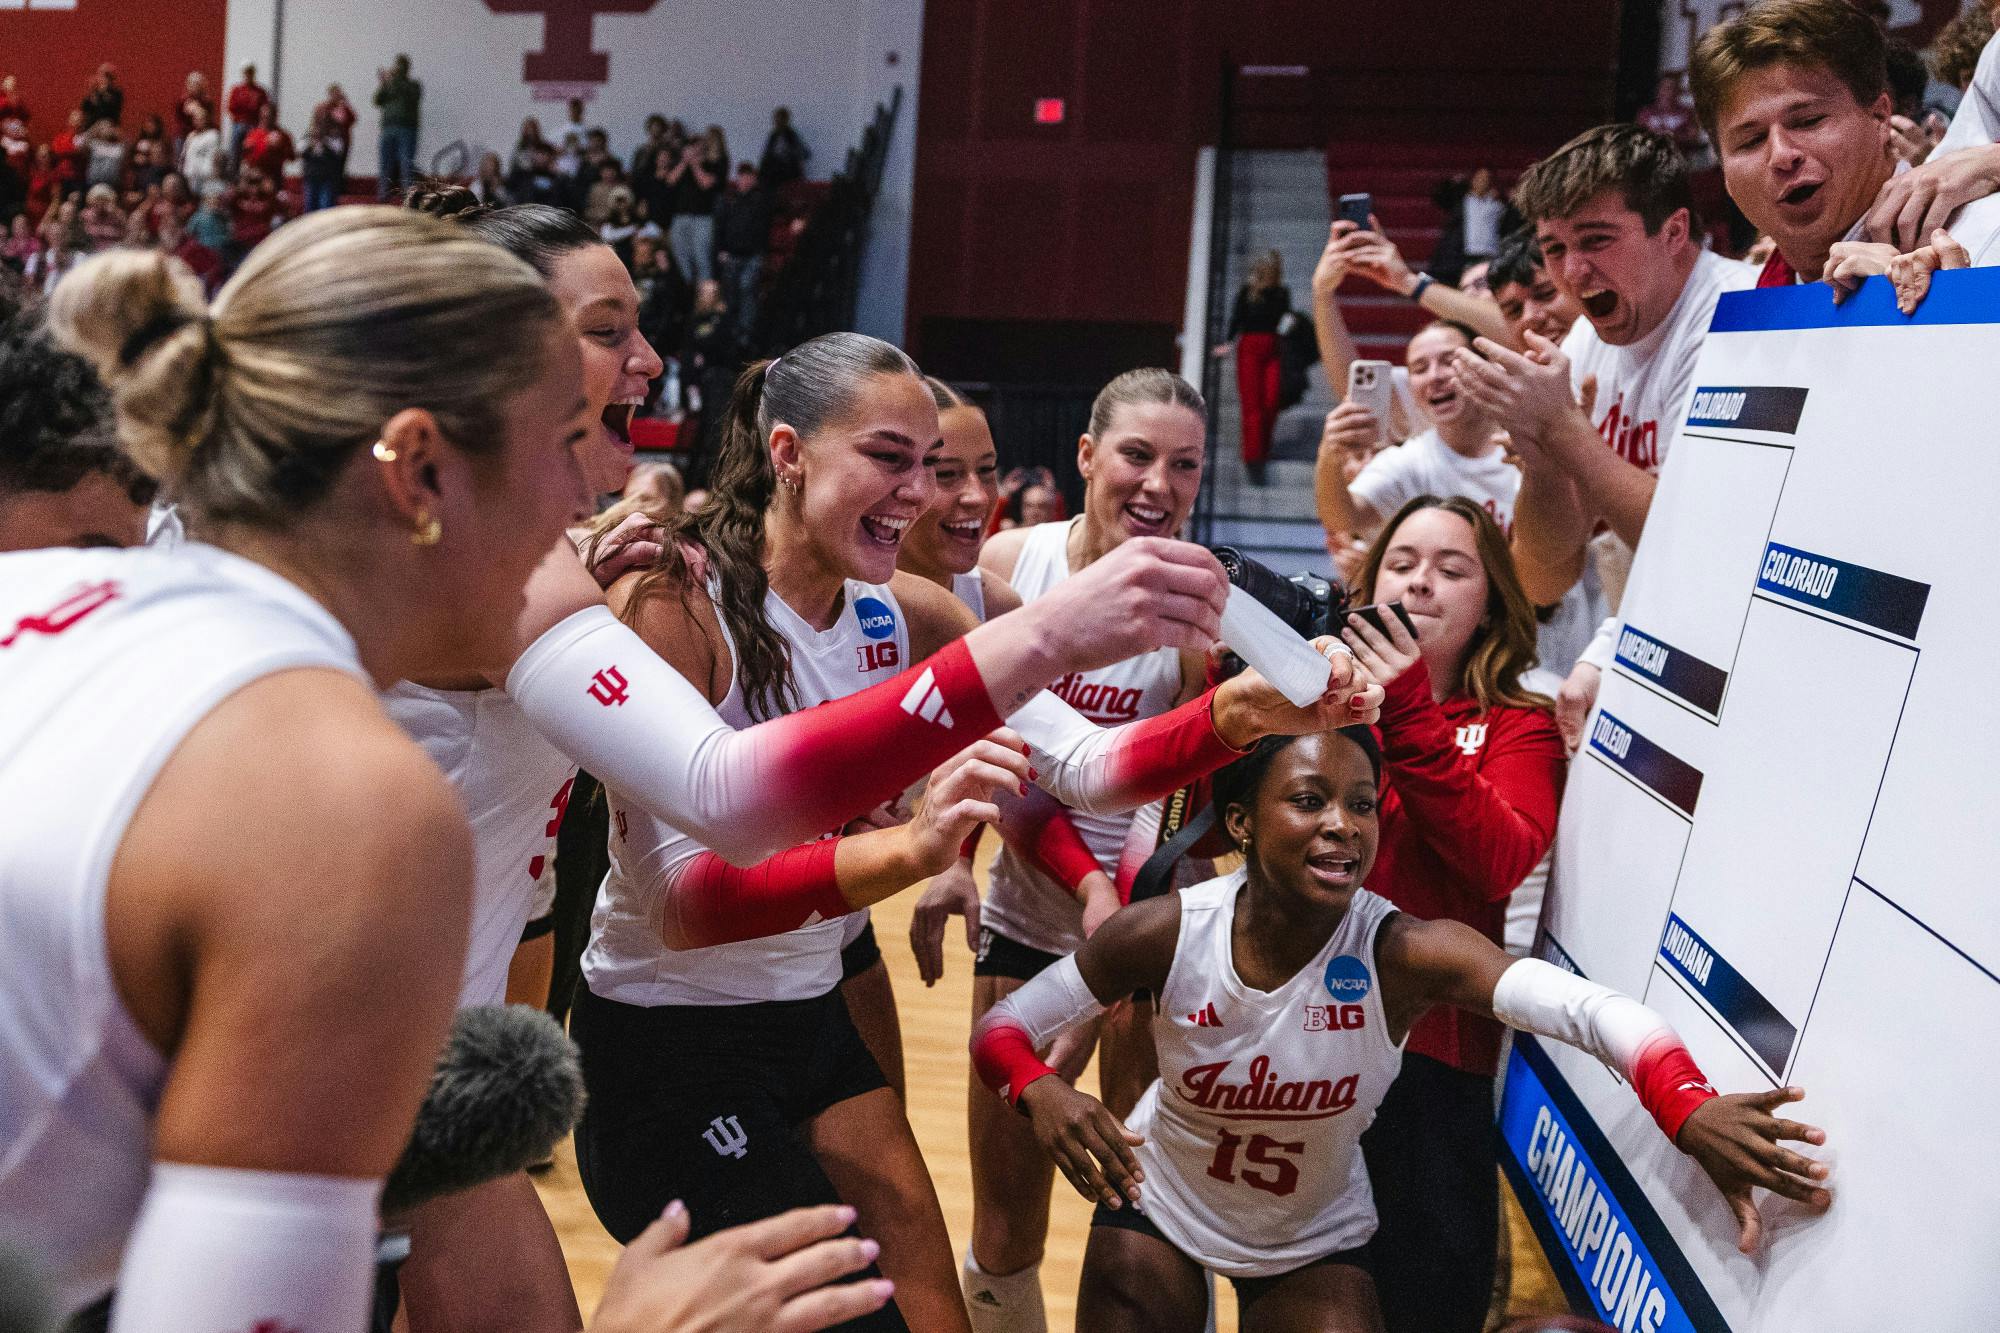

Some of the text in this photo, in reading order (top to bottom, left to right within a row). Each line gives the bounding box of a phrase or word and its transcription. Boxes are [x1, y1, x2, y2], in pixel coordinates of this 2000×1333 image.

[1689, 392, 1747, 421] COLORADO
[1761, 549, 1839, 600] COLORADO
[860, 615, 894, 630] NCAA
[1618, 630, 1669, 678] AMERICAN
[1048, 671, 1144, 723] diana
[1593, 714, 1633, 760] TOLEDO
[1163, 788, 1187, 842] Canon
[1662, 920, 1714, 987] INDIANA
[1330, 977, 1368, 991] NCAA
[1176, 1055, 1361, 1121] Indiana
[1206, 1126, 1306, 1198] 15
[1527, 1105, 1666, 1333] CHAMPIONS
